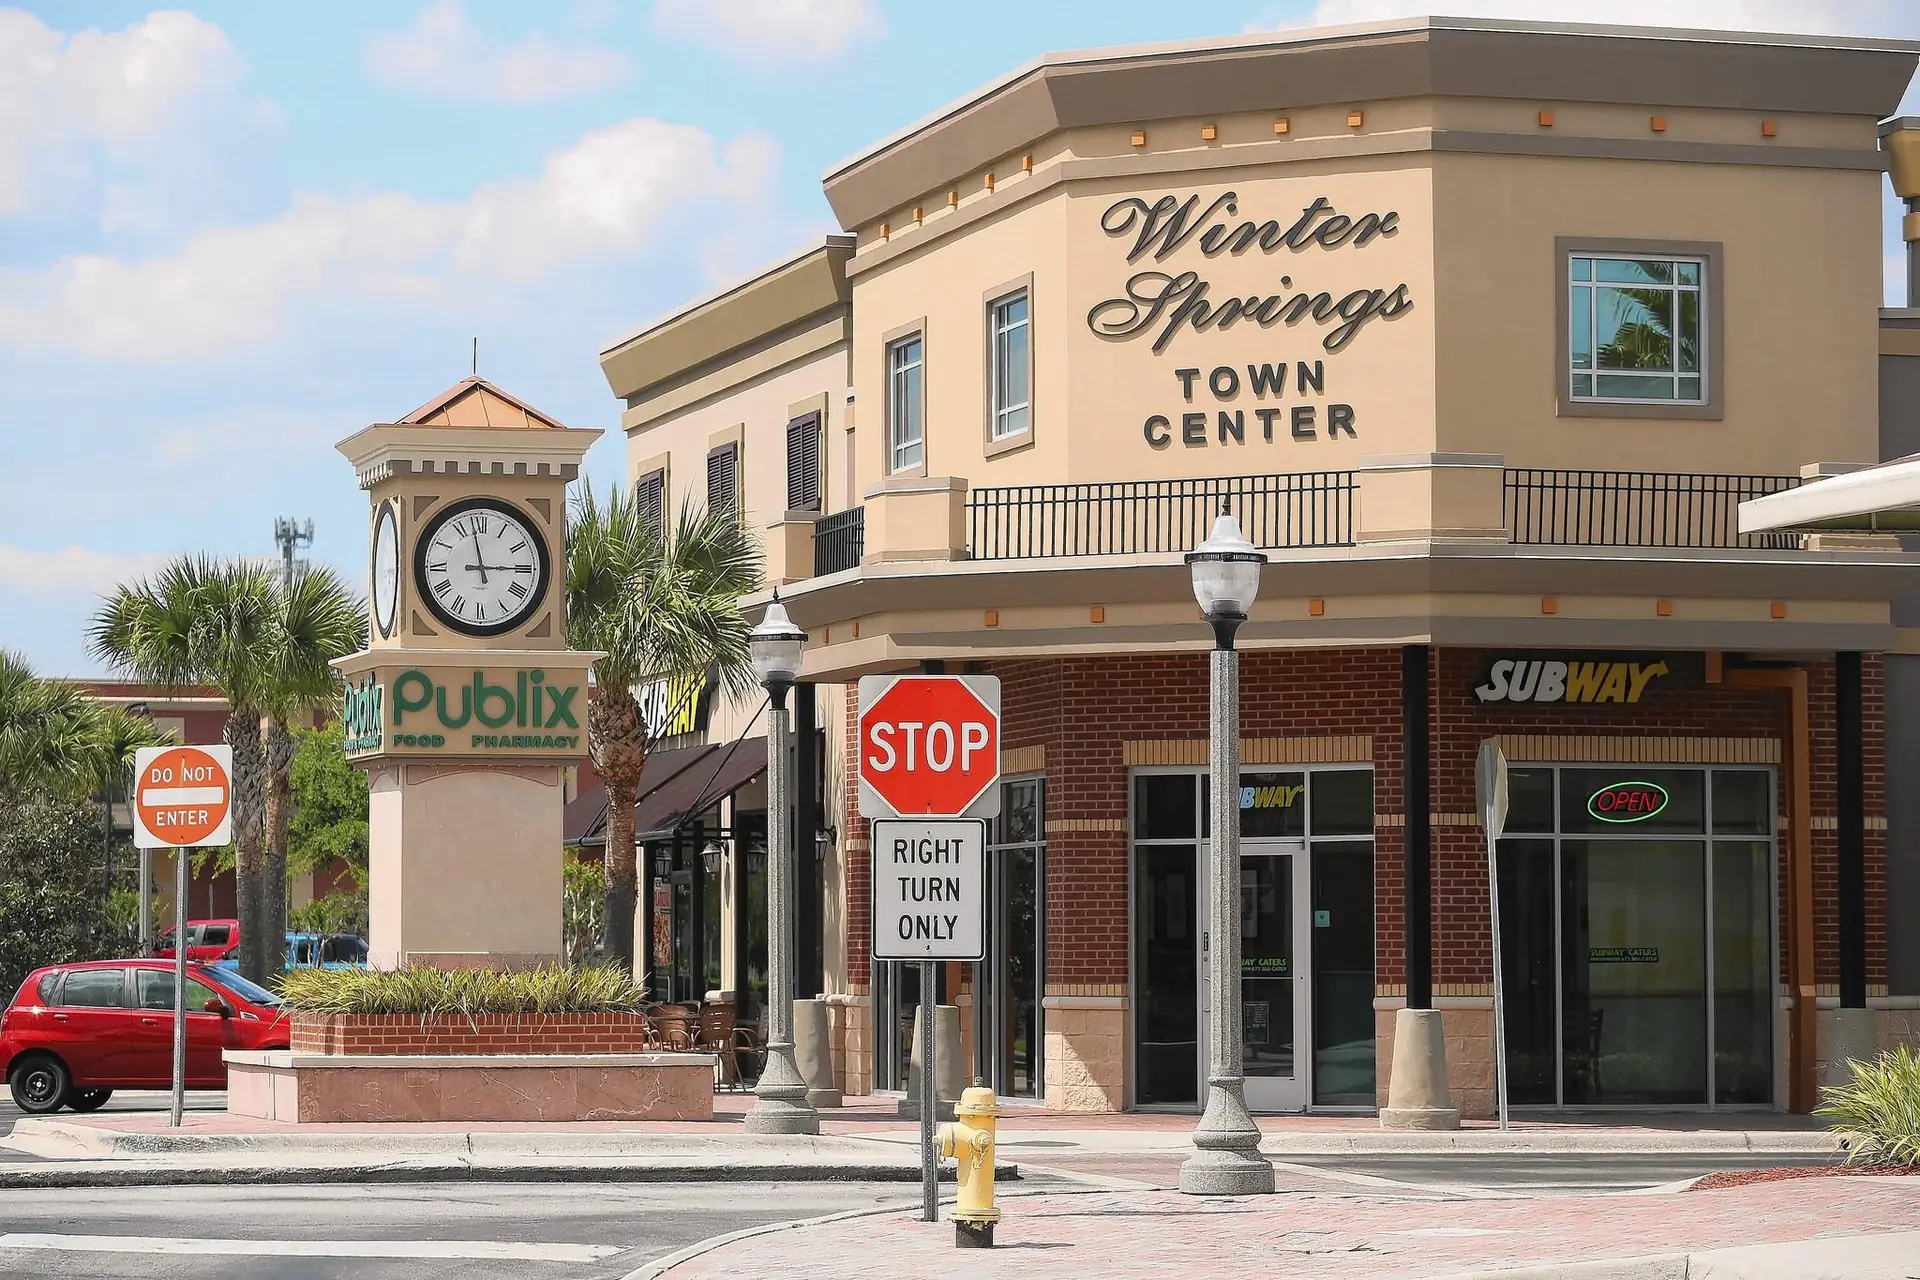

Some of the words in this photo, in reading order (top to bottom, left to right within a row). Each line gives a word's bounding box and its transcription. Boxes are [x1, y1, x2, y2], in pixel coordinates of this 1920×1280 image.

[1100, 191, 1401, 266] Winter
[1087, 270, 1415, 356] Springs
[1174, 360, 1325, 404] TOWN
[1143, 403, 1358, 451] CENTER
[1475, 660, 1669, 703] SUBWAY
[392, 669, 580, 729] Publix
[393, 734, 445, 747] FOOD
[471, 735, 580, 748] PHARMACY
[868, 721, 990, 773] STOP
[151, 767, 173, 783] DO
[183, 766, 214, 782] NOT
[1597, 792, 1658, 812] OPEN
[156, 809, 208, 826] ENTER
[893, 838, 964, 865] RIGHT
[898, 877, 960, 902] TURN
[898, 914, 959, 940] ONLY
[1258, 958, 1287, 966] CATERS
